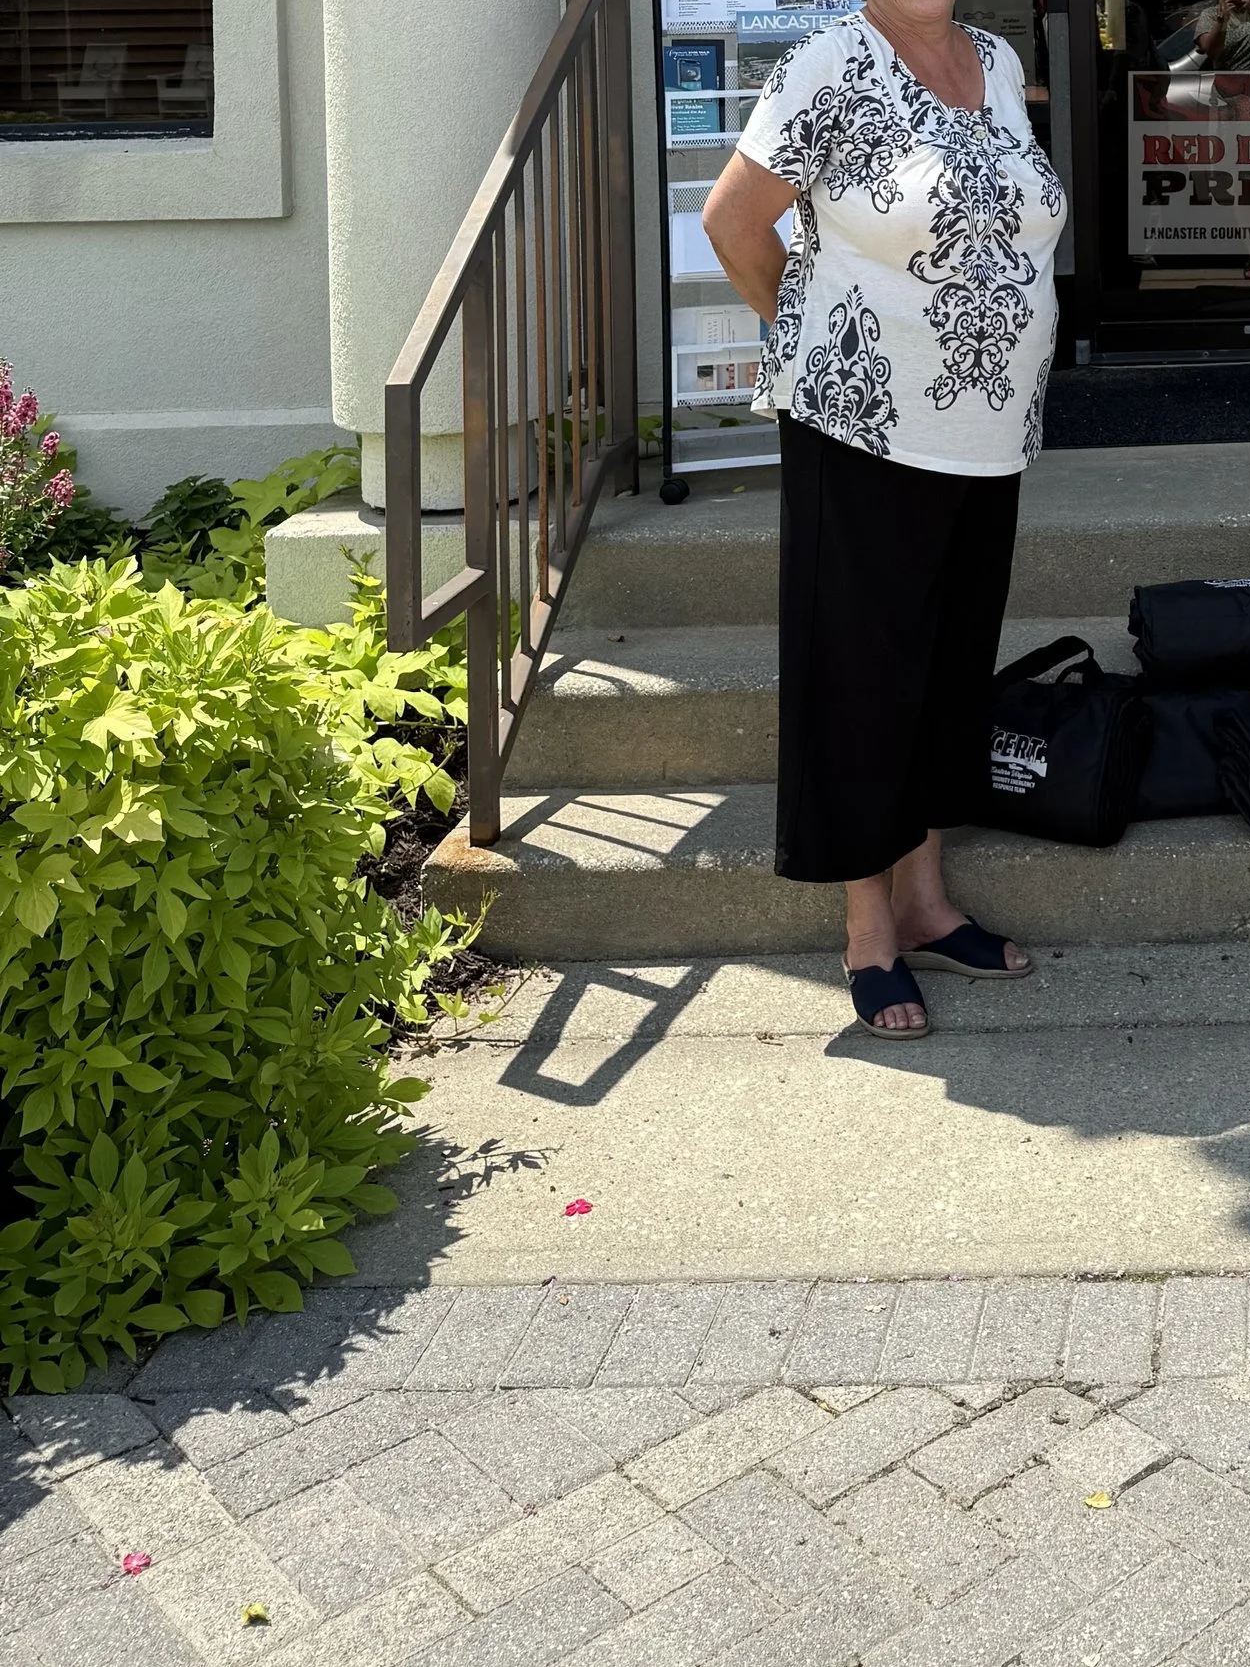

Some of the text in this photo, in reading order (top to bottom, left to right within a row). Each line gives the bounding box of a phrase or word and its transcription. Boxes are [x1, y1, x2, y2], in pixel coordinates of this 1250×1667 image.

[1142, 134, 1226, 165] RED
[1143, 226, 1208, 240] LANCASTER
[990, 730, 1045, 763] CERT
